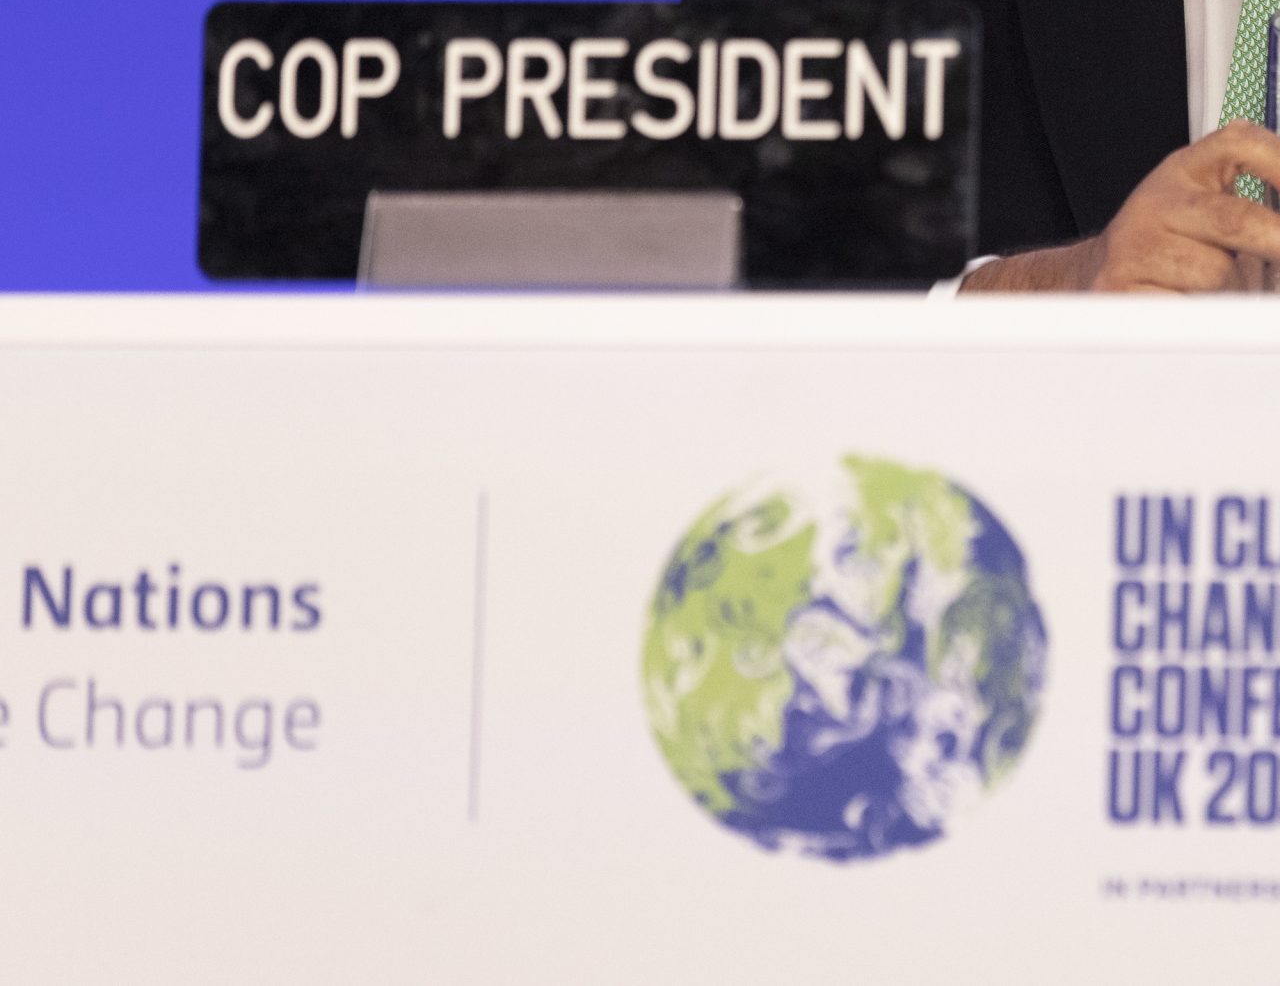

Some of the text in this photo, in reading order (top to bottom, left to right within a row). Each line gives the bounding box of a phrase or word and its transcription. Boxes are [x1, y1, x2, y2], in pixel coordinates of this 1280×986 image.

[217, 37, 962, 141] COP PRESIDENT
[1113, 494, 1195, 570] UN
[21, 562, 323, 632] Nations
[36, 676, 323, 771] Change
[1105, 749, 1188, 826] UK
